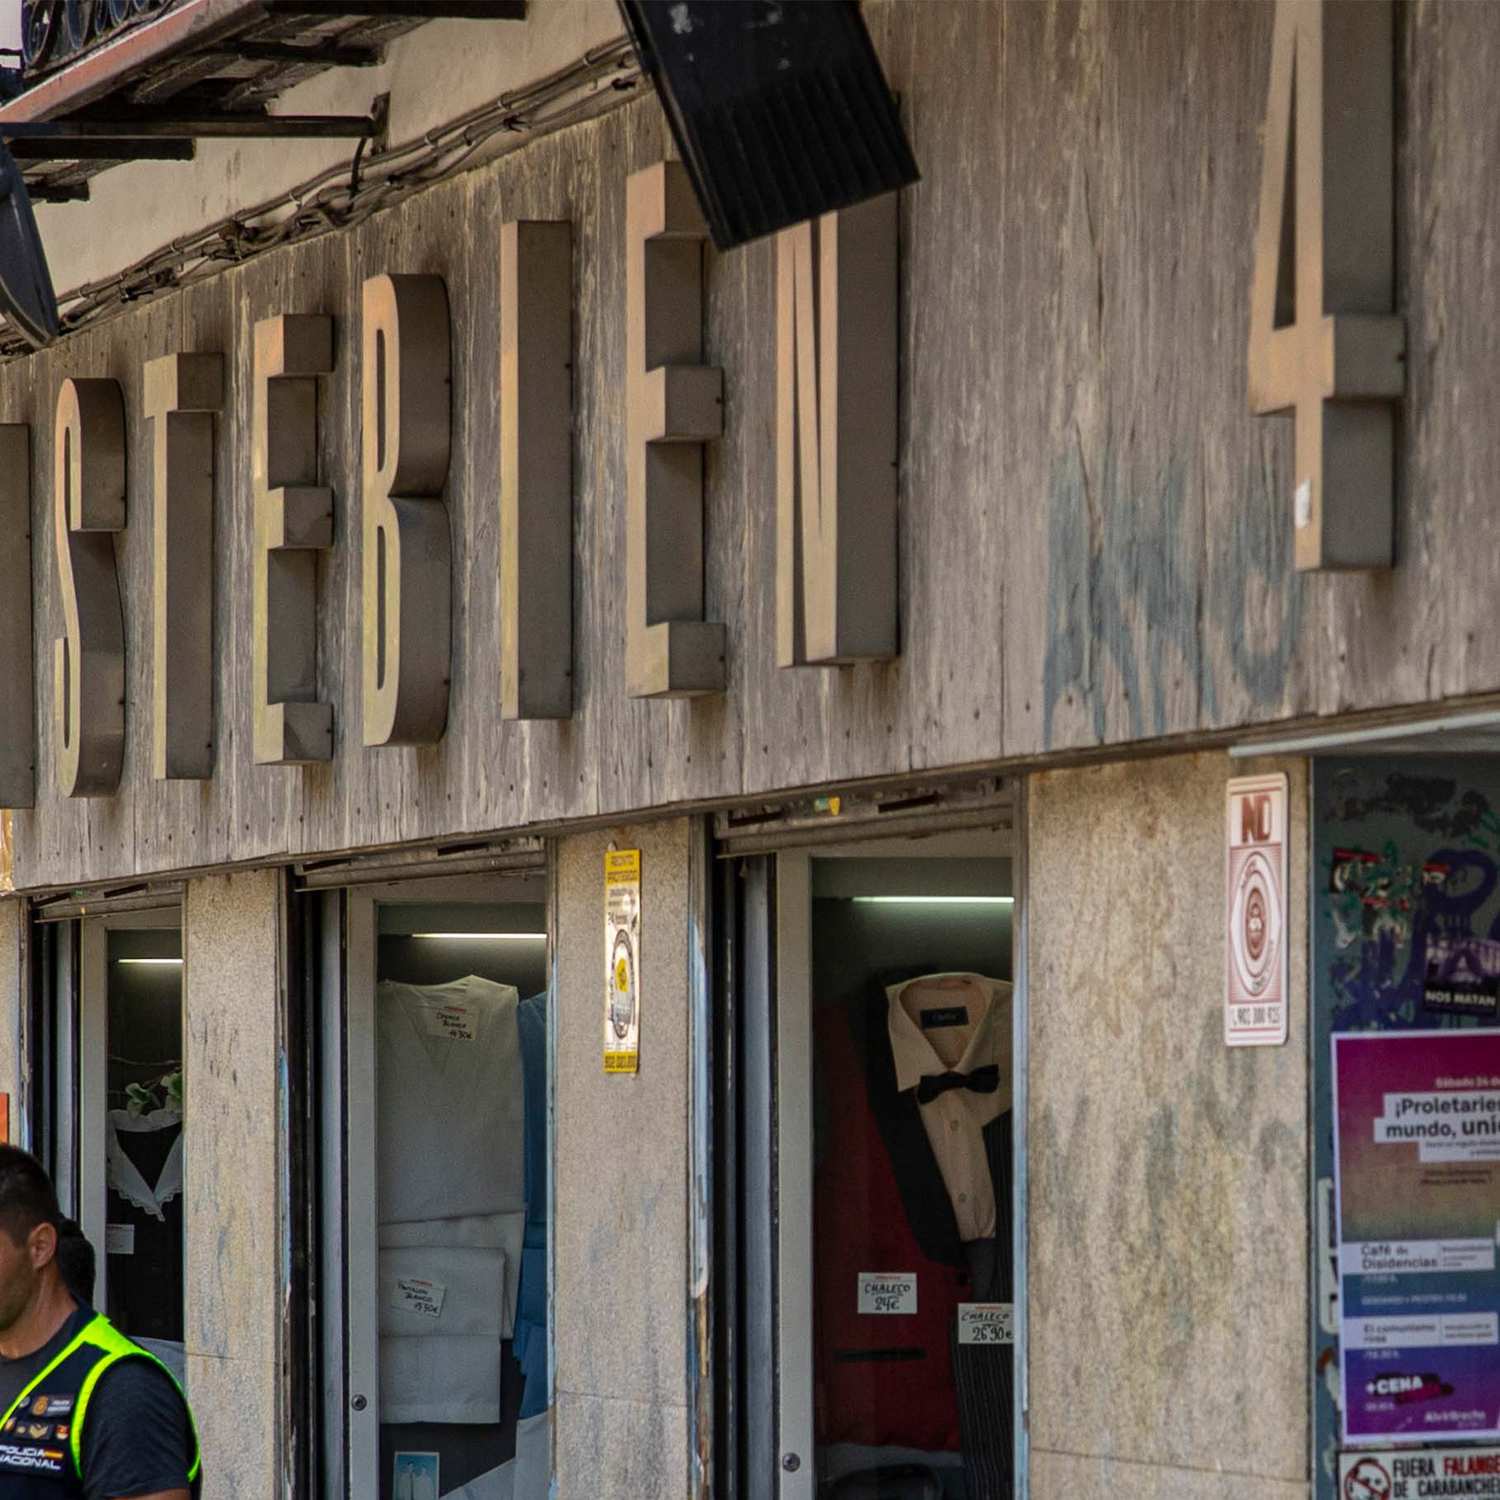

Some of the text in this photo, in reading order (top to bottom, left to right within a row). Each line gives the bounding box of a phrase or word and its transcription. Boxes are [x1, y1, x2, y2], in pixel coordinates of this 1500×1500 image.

[1247, 0, 1403, 572] 4
[1396, 1097, 1500, 1119] ¡Proletarie
[1386, 1121, 1457, 1138] mundo,
[1392, 1458, 1436, 1478] FUERA
[1393, 1477, 1500, 1498] DE CARABANCHE
